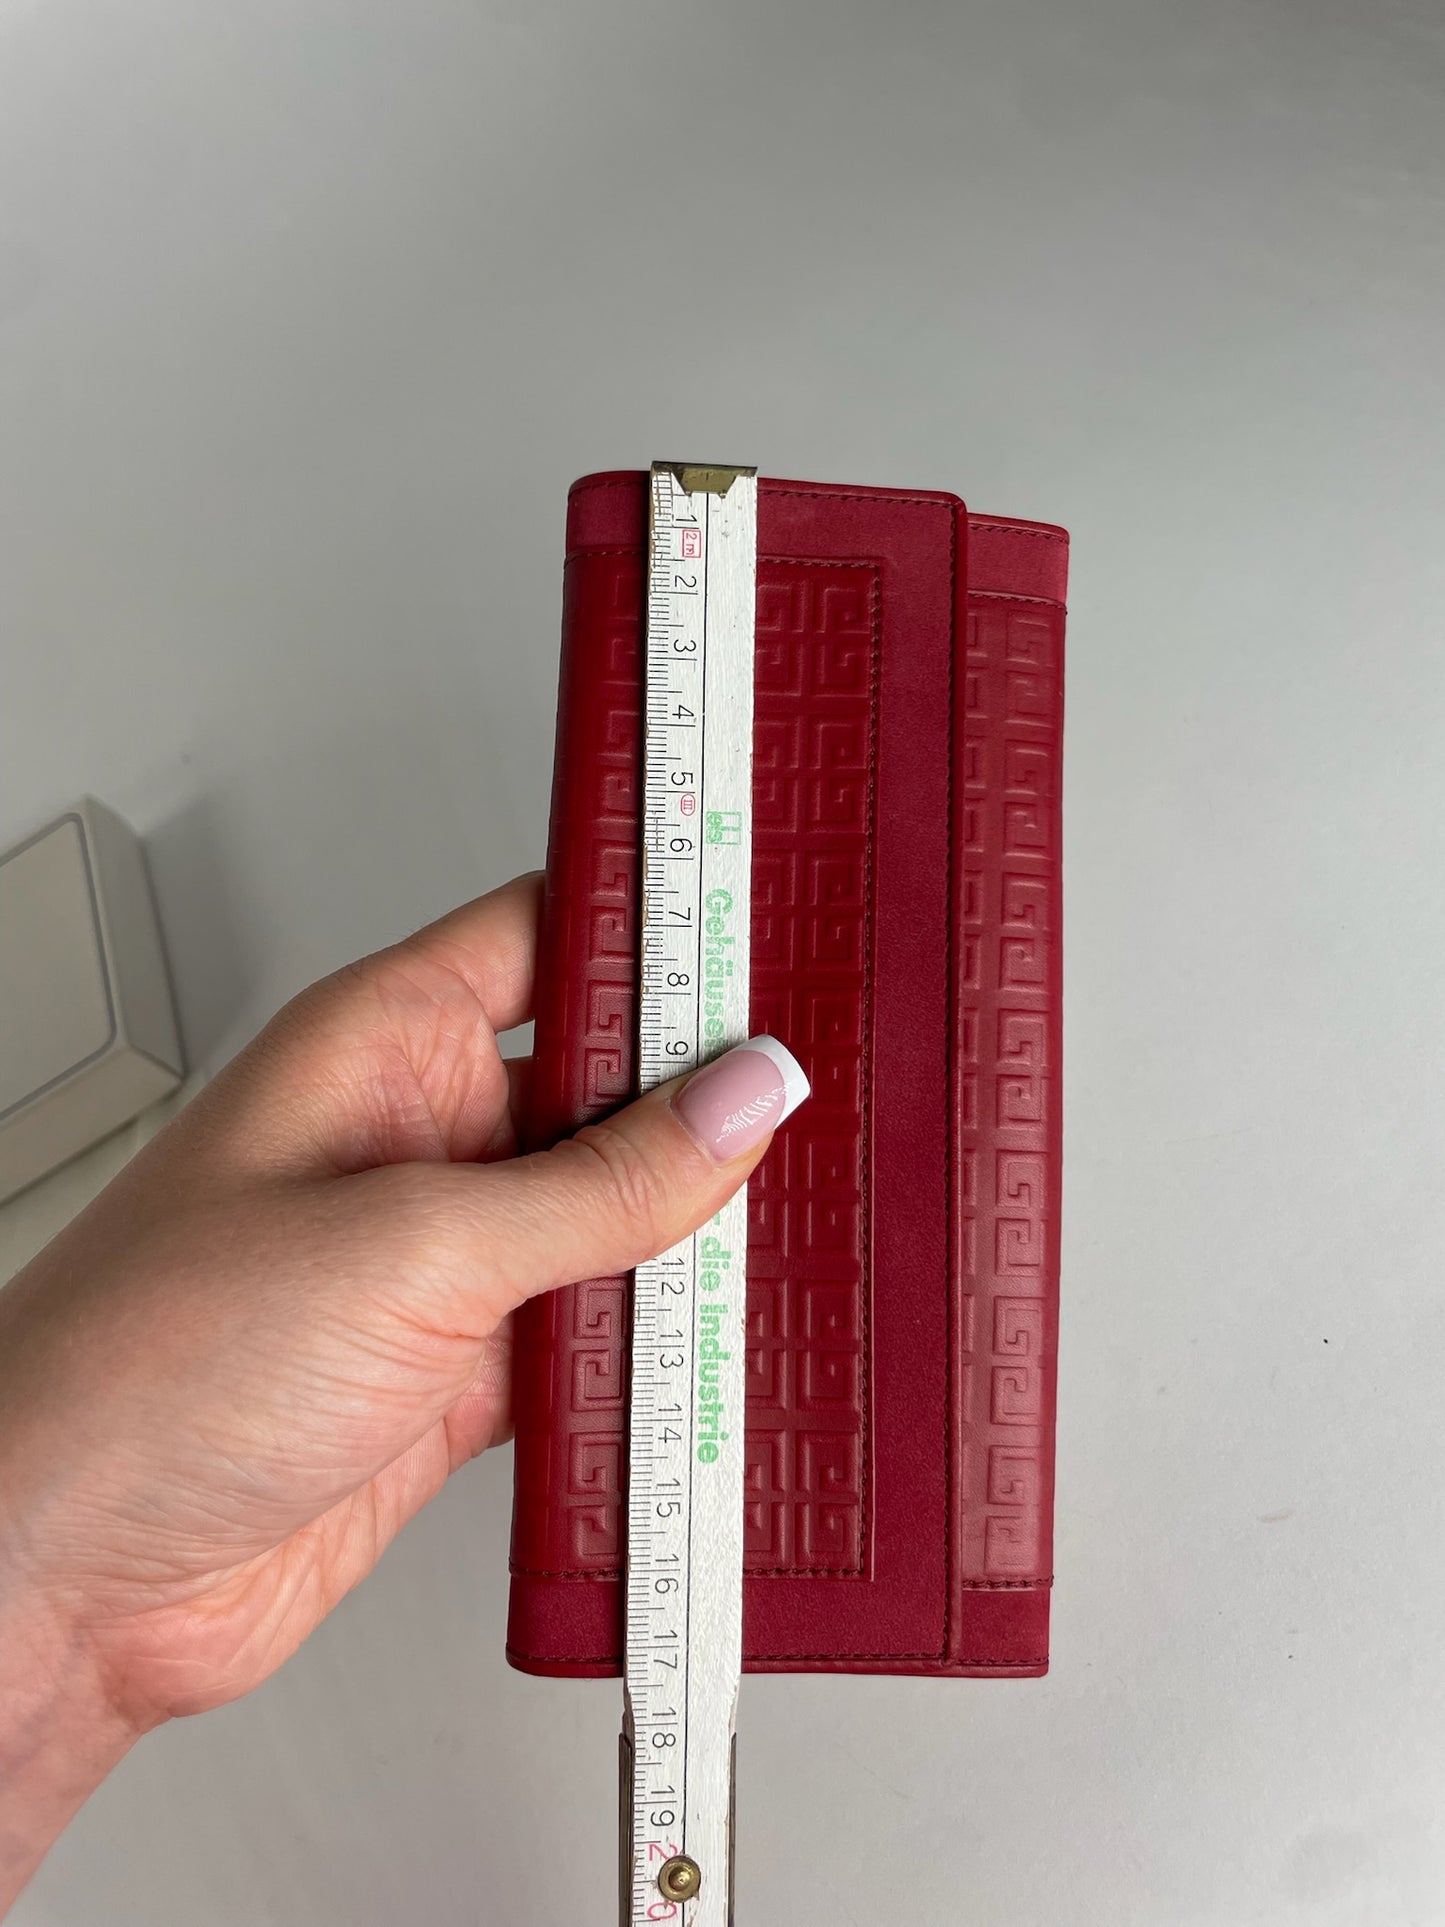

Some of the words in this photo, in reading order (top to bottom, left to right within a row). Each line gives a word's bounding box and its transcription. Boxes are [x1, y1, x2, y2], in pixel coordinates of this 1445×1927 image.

[675, 514, 698, 523] 1
[674, 575, 697, 588] 2
[673, 639, 697, 653] 3
[672, 704, 695, 719] 4
[671, 771, 694, 786] 5
[670, 838, 693, 853] 6
[668, 907, 691, 921] 7
[667, 972, 690, 987] 8
[665, 1040, 689, 1056] 9
[661, 1257, 685, 1296] 12
[700, 1236, 731, 1291] die
[659, 1329, 684, 1369] 13
[697, 1304, 731, 1464] Industrie
[658, 1403, 682, 1444] 14
[656, 1478, 681, 1518] 15
[655, 1553, 679, 1594] 16
[653, 1629, 678, 1669] 17
[652, 1707, 677, 1748] 18
[650, 1785, 675, 1827] 19
